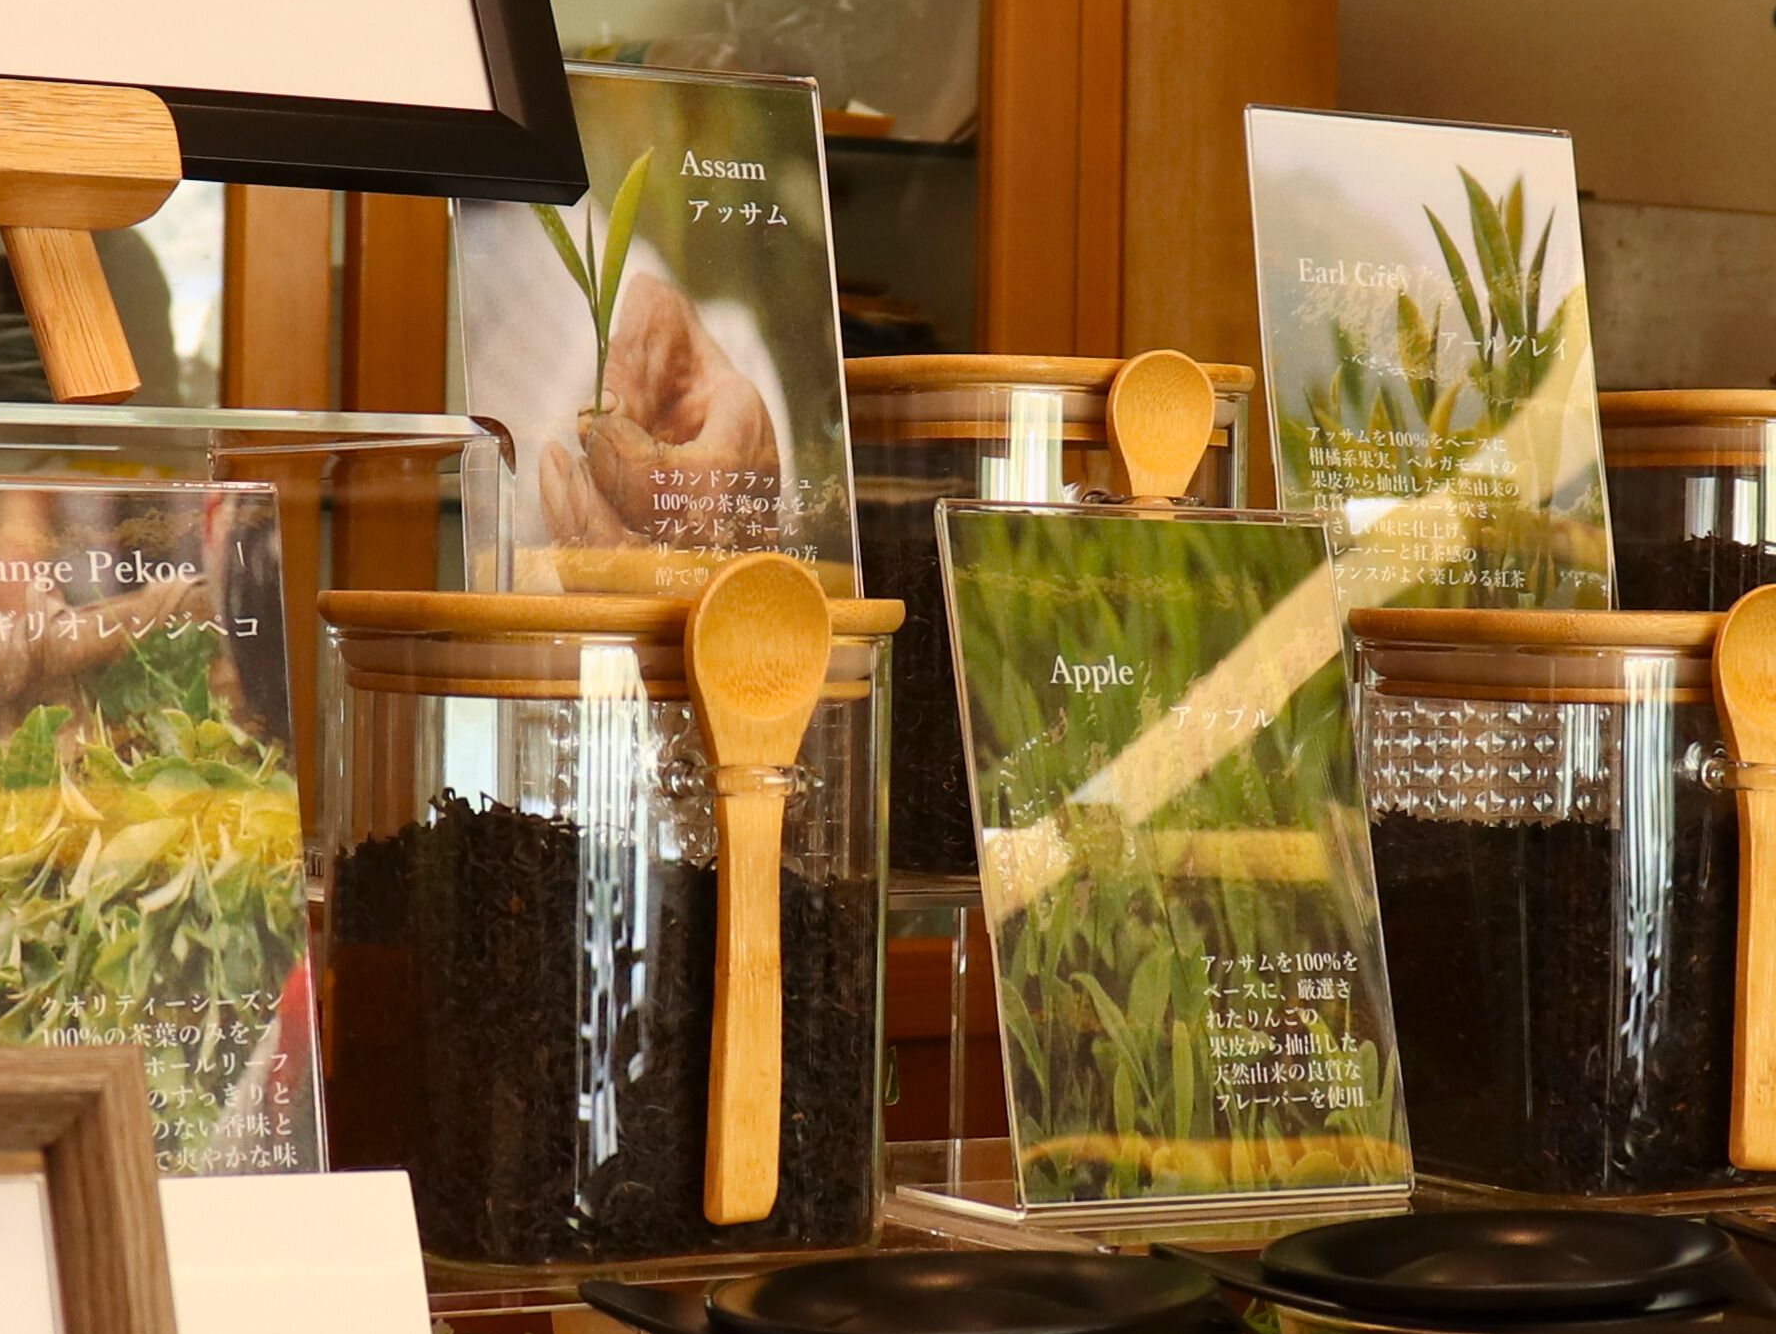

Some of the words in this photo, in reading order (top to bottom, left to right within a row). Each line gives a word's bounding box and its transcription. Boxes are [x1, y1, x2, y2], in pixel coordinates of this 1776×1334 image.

[679, 149, 767, 182] Assam
[687, 197, 789, 227] アッサム
[1297, 257, 1346, 285] Earl
[1354, 258, 1410, 295] Grey
[1440, 331, 1568, 362] アールグレイ
[1306, 425, 1508, 453] アッサムを100%をベースに
[649, 468, 813, 490] セカンドフラッシュ
[651, 492, 806, 515] 100%の茶葉のみを
[86, 549, 198, 585] Pekoe
[1049, 653, 1135, 689] Apple
[1168, 702, 1275, 731] アップル
[1199, 950, 1359, 975] アッサムを100%を
[39, 991, 285, 1019] クオリティーシーズン
[1206, 1006, 1319, 1029] れたりんごの
[1209, 1031, 1359, 1059] 果皮から抽出した
[1216, 1085, 1372, 1112] フレーバーを使用。
